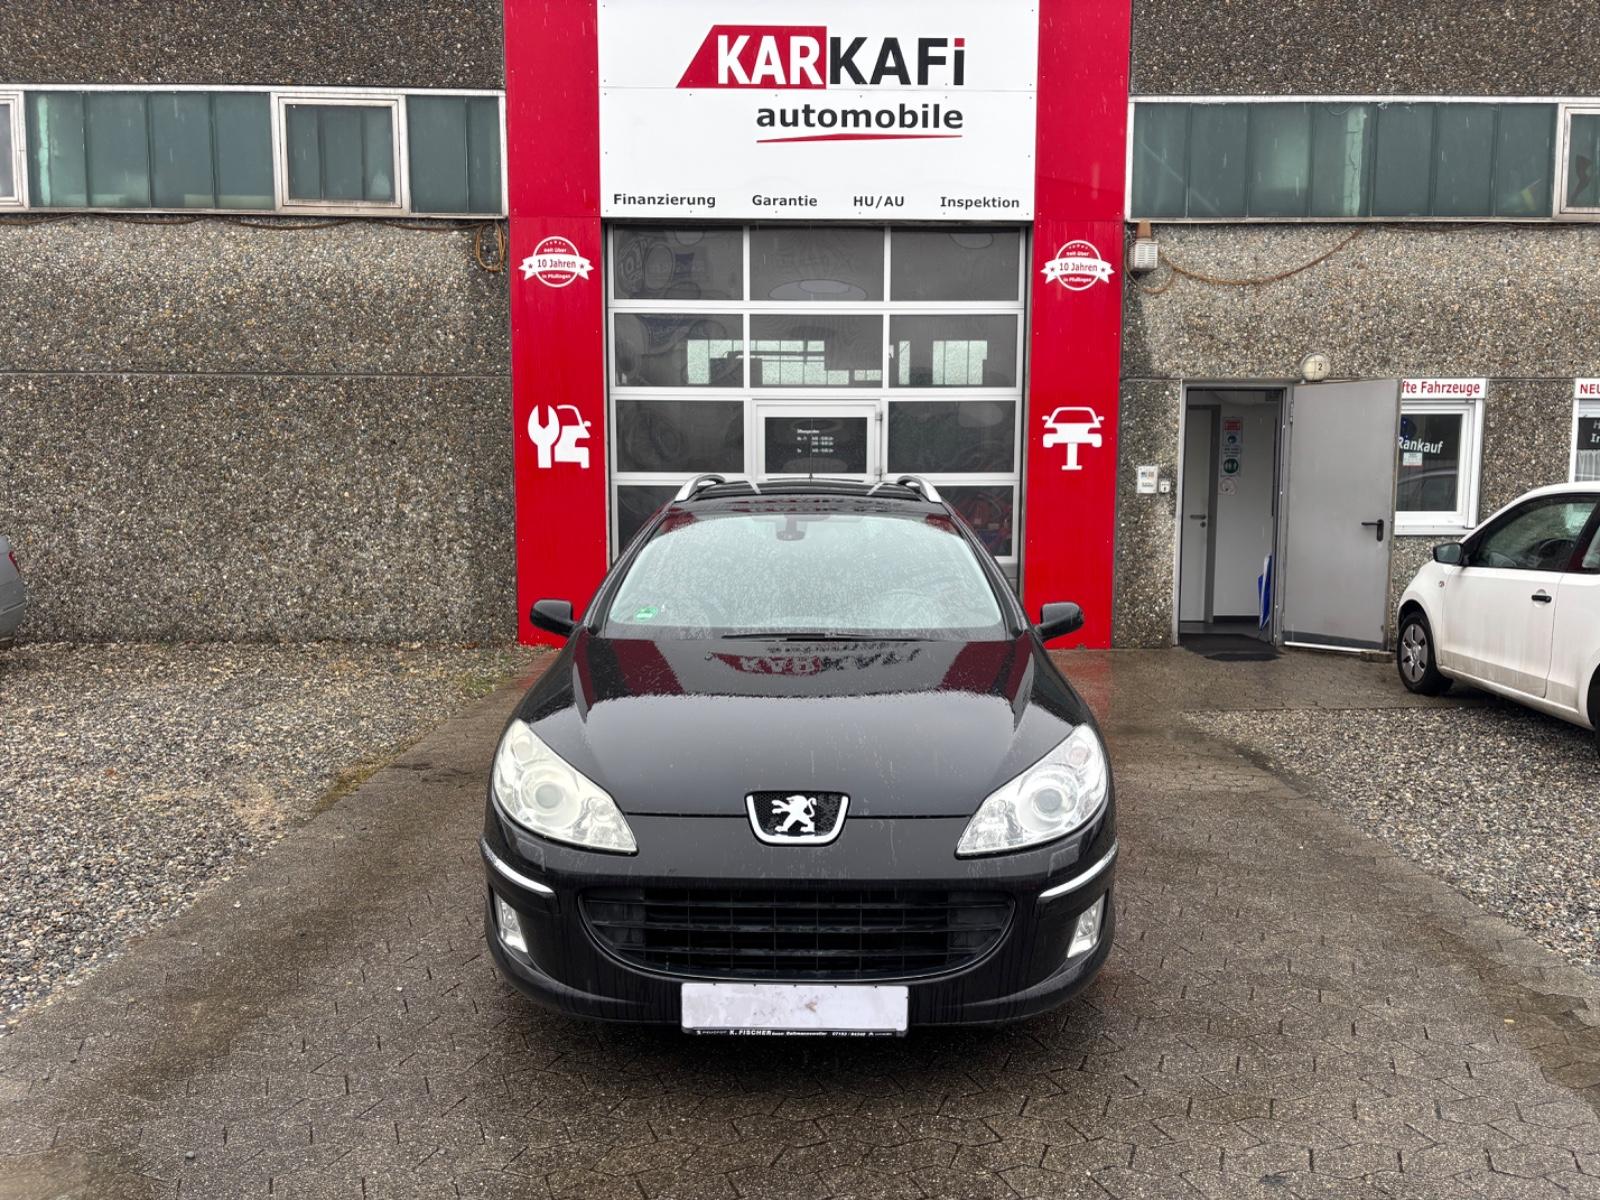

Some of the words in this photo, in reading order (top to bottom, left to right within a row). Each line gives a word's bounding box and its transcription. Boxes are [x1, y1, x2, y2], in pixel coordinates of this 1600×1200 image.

[756, 103, 963, 129] automobile
[613, 193, 716, 208] Finanzierung
[752, 195, 818, 207] Garantie
[853, 195, 905, 209] HU/AU
[940, 196, 1020, 210] Inspektion
[537, 259, 547, 268] 10
[549, 259, 576, 268] Jahren
[1059, 262, 1069, 271] 10
[1071, 262, 1098, 271] Jahren
[1420, 380, 1480, 397] Fahrzeuge
